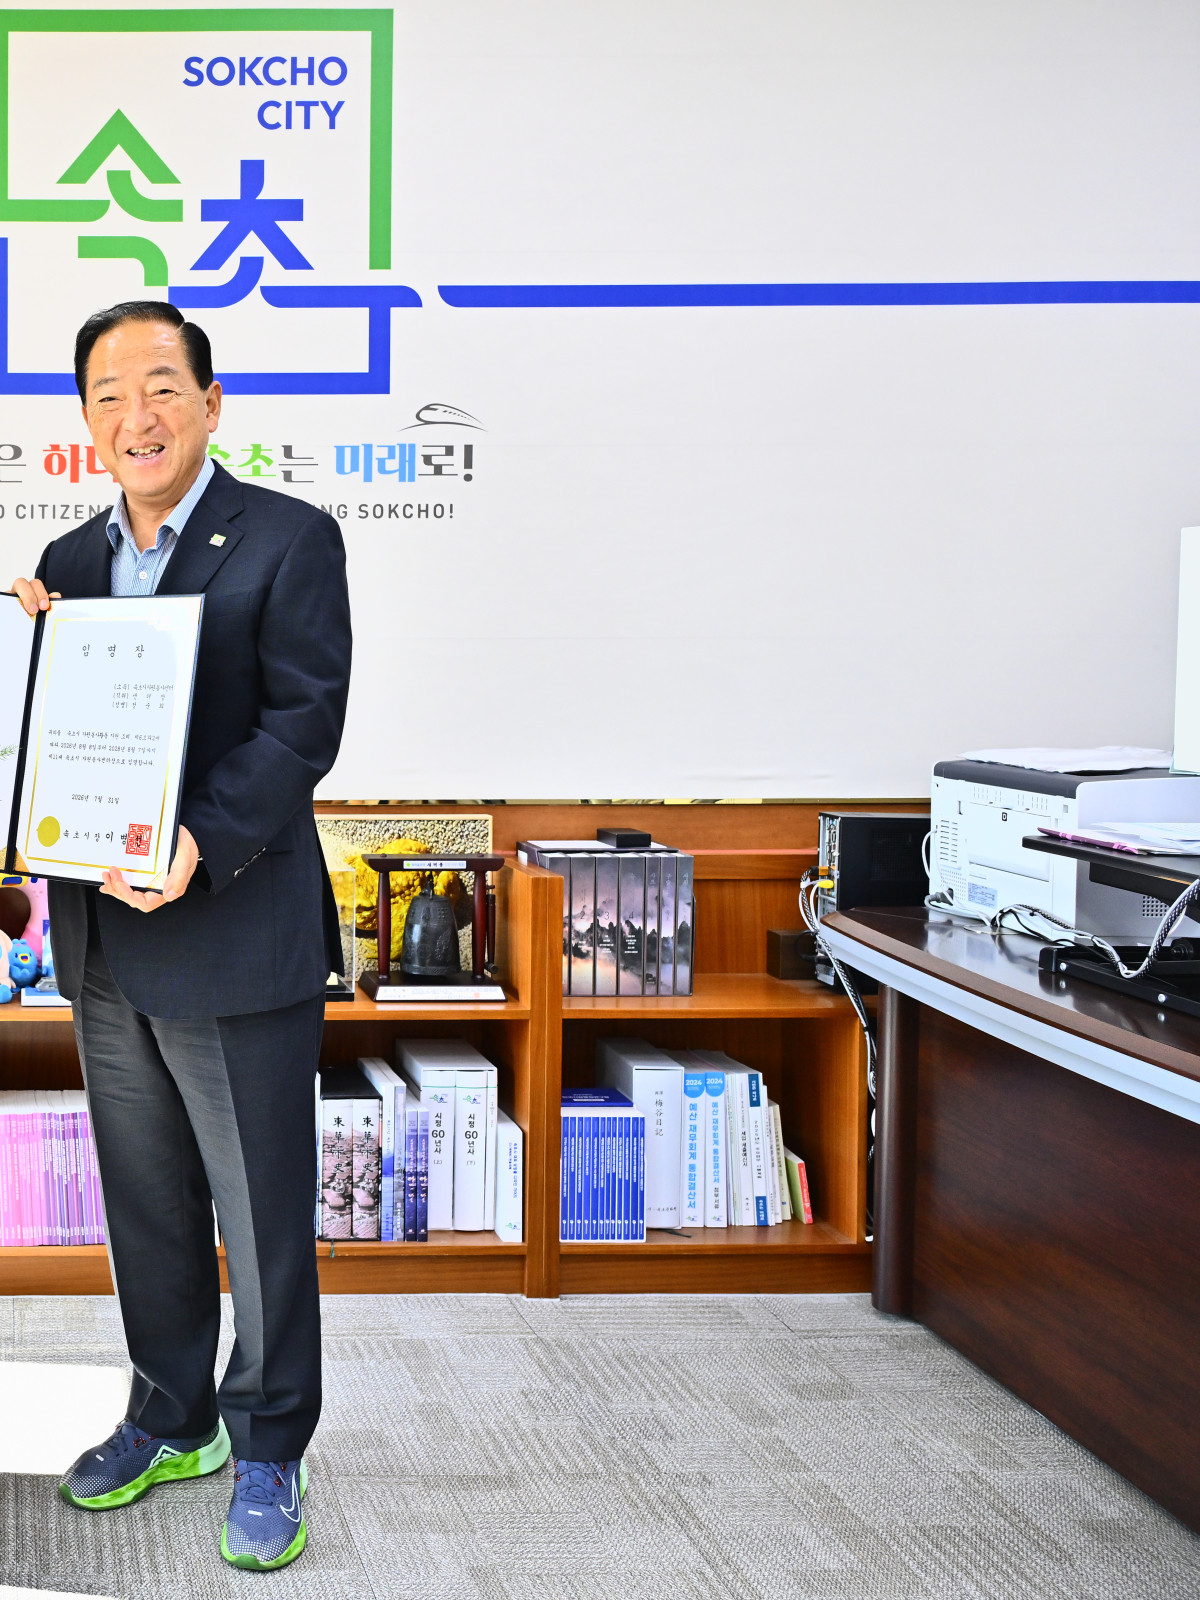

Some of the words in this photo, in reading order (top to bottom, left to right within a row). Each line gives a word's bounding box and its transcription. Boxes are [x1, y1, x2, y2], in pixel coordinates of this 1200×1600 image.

[182, 55, 349, 87] SOKCHO
[256, 100, 346, 130] CITY
[334, 443, 473, 483] 미래로!
[358, 503, 454, 519] SOKCHO!
[689, 1103, 697, 1121] 예산
[688, 1124, 697, 1160] 재무회계
[687, 1163, 697, 1209] 통합결산서
